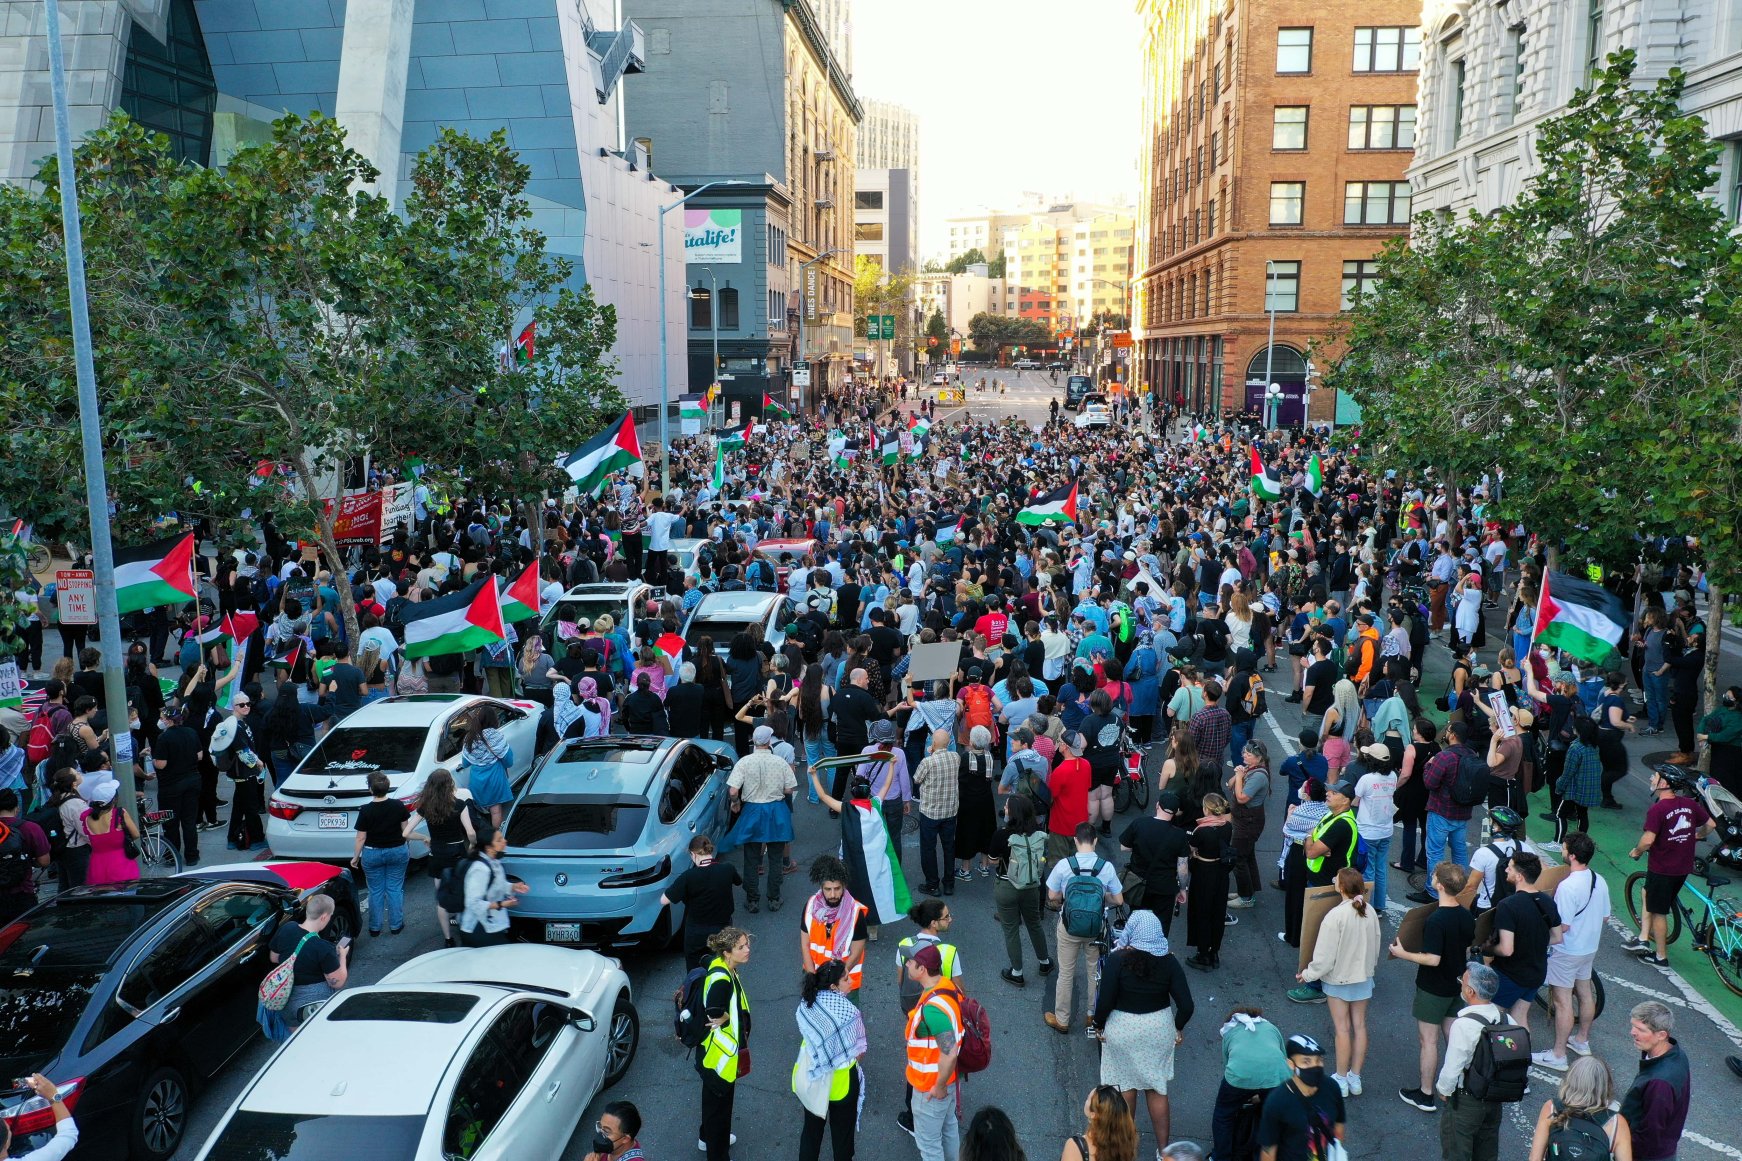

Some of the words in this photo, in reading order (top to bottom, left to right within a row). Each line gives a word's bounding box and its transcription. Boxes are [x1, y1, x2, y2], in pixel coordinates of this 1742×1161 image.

[807, 269, 816, 296] DANCE
[807, 298, 816, 320] LINES
[58, 578, 68, 589] NO
[68, 594, 85, 602] ANY
[68, 603, 87, 613] TIME
[320, 818, 346, 827] 9CPK936
